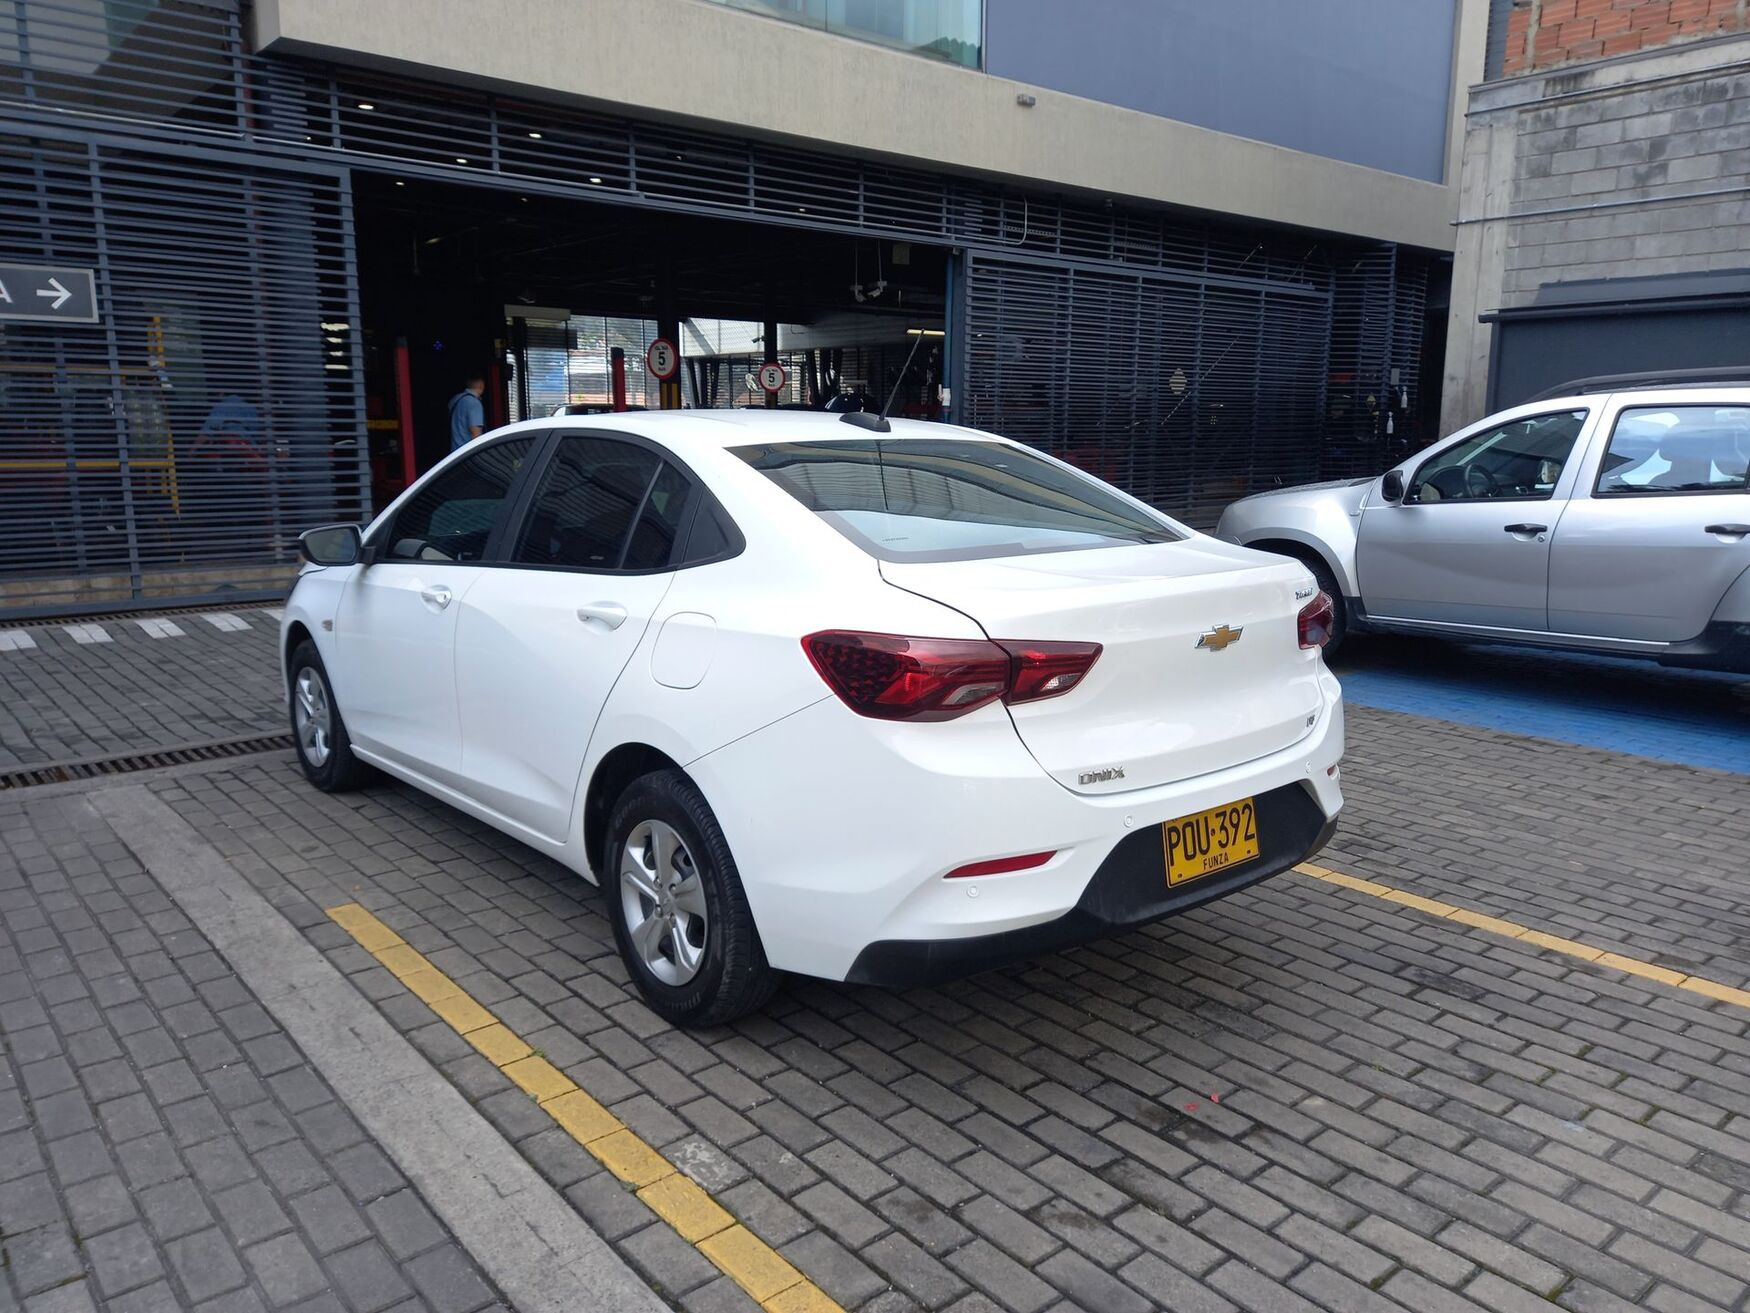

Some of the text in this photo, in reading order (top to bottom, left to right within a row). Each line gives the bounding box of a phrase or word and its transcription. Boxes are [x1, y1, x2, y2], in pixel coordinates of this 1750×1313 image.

[658, 351, 666, 366] 5
[768, 372, 775, 383] 5
[1078, 766, 1125, 785] ONIX
[1203, 852, 1229, 871] FUNZA
